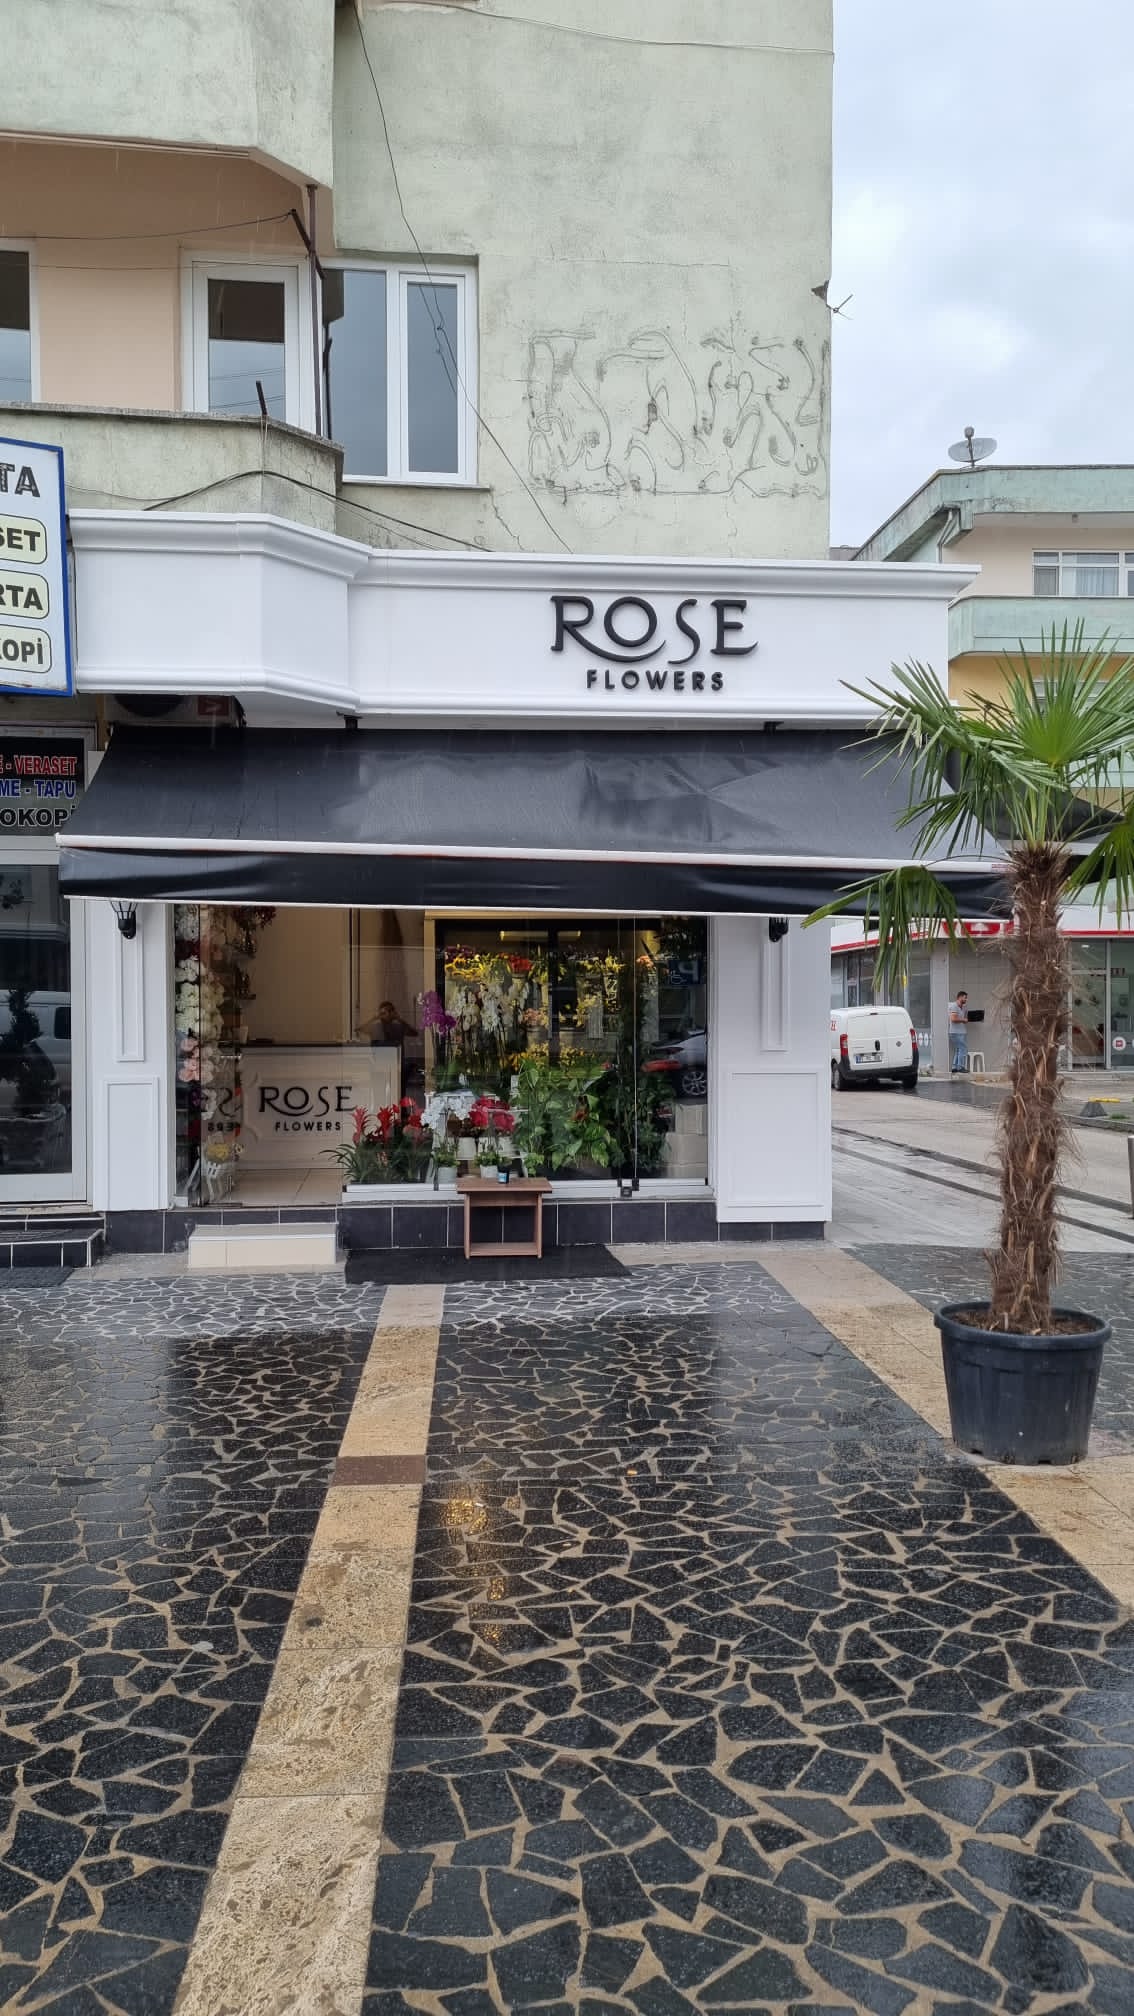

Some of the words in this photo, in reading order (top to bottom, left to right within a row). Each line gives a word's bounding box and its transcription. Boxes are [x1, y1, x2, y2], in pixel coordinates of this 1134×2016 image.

[550, 595, 758, 664] ROSE
[0, 637, 43, 664] OPİ
[586, 669, 724, 691] FLOWERS
[14, 755, 77, 775] VERASET
[34, 780, 76, 799] TAPU
[258, 1086, 357, 1117] ROSE
[275, 1121, 341, 1131] FLOWERS
